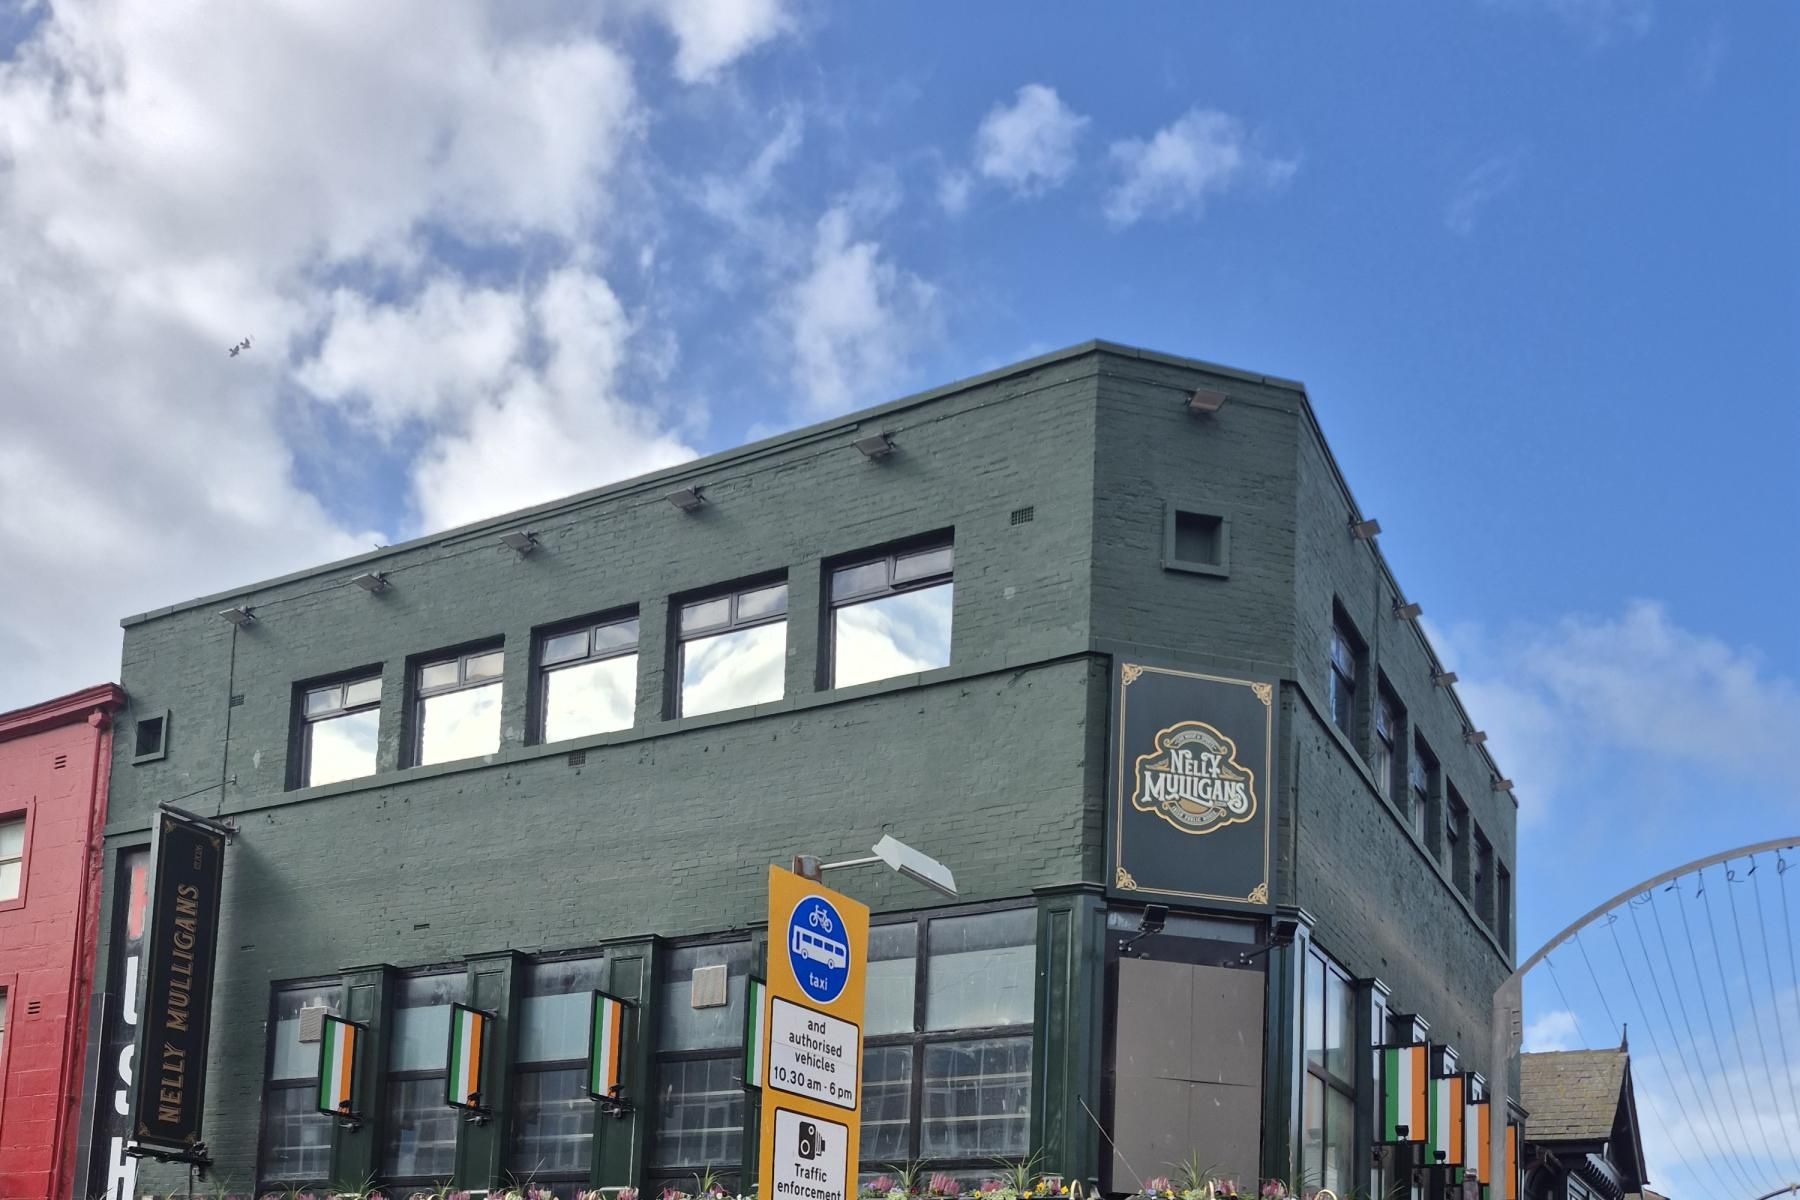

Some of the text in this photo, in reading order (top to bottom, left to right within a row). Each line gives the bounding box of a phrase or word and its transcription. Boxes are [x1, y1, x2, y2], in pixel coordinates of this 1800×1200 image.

[1170, 749, 1222, 778] NELLY
[1141, 771, 1248, 814] MULLIGANS
[809, 972, 828, 991] taxi
[158, 883, 200, 1124] NELLY MULLIGANS
[808, 1020, 826, 1035] and
[789, 1032, 842, 1058] authorised
[795, 1052, 835, 1074] vehicles
[774, 1066, 805, 1087] 10.30
[807, 1078, 822, 1092] am
[829, 1082, 836, 1095] 6
[837, 1087, 852, 1100] pm
[794, 1163, 827, 1183] Traffic
